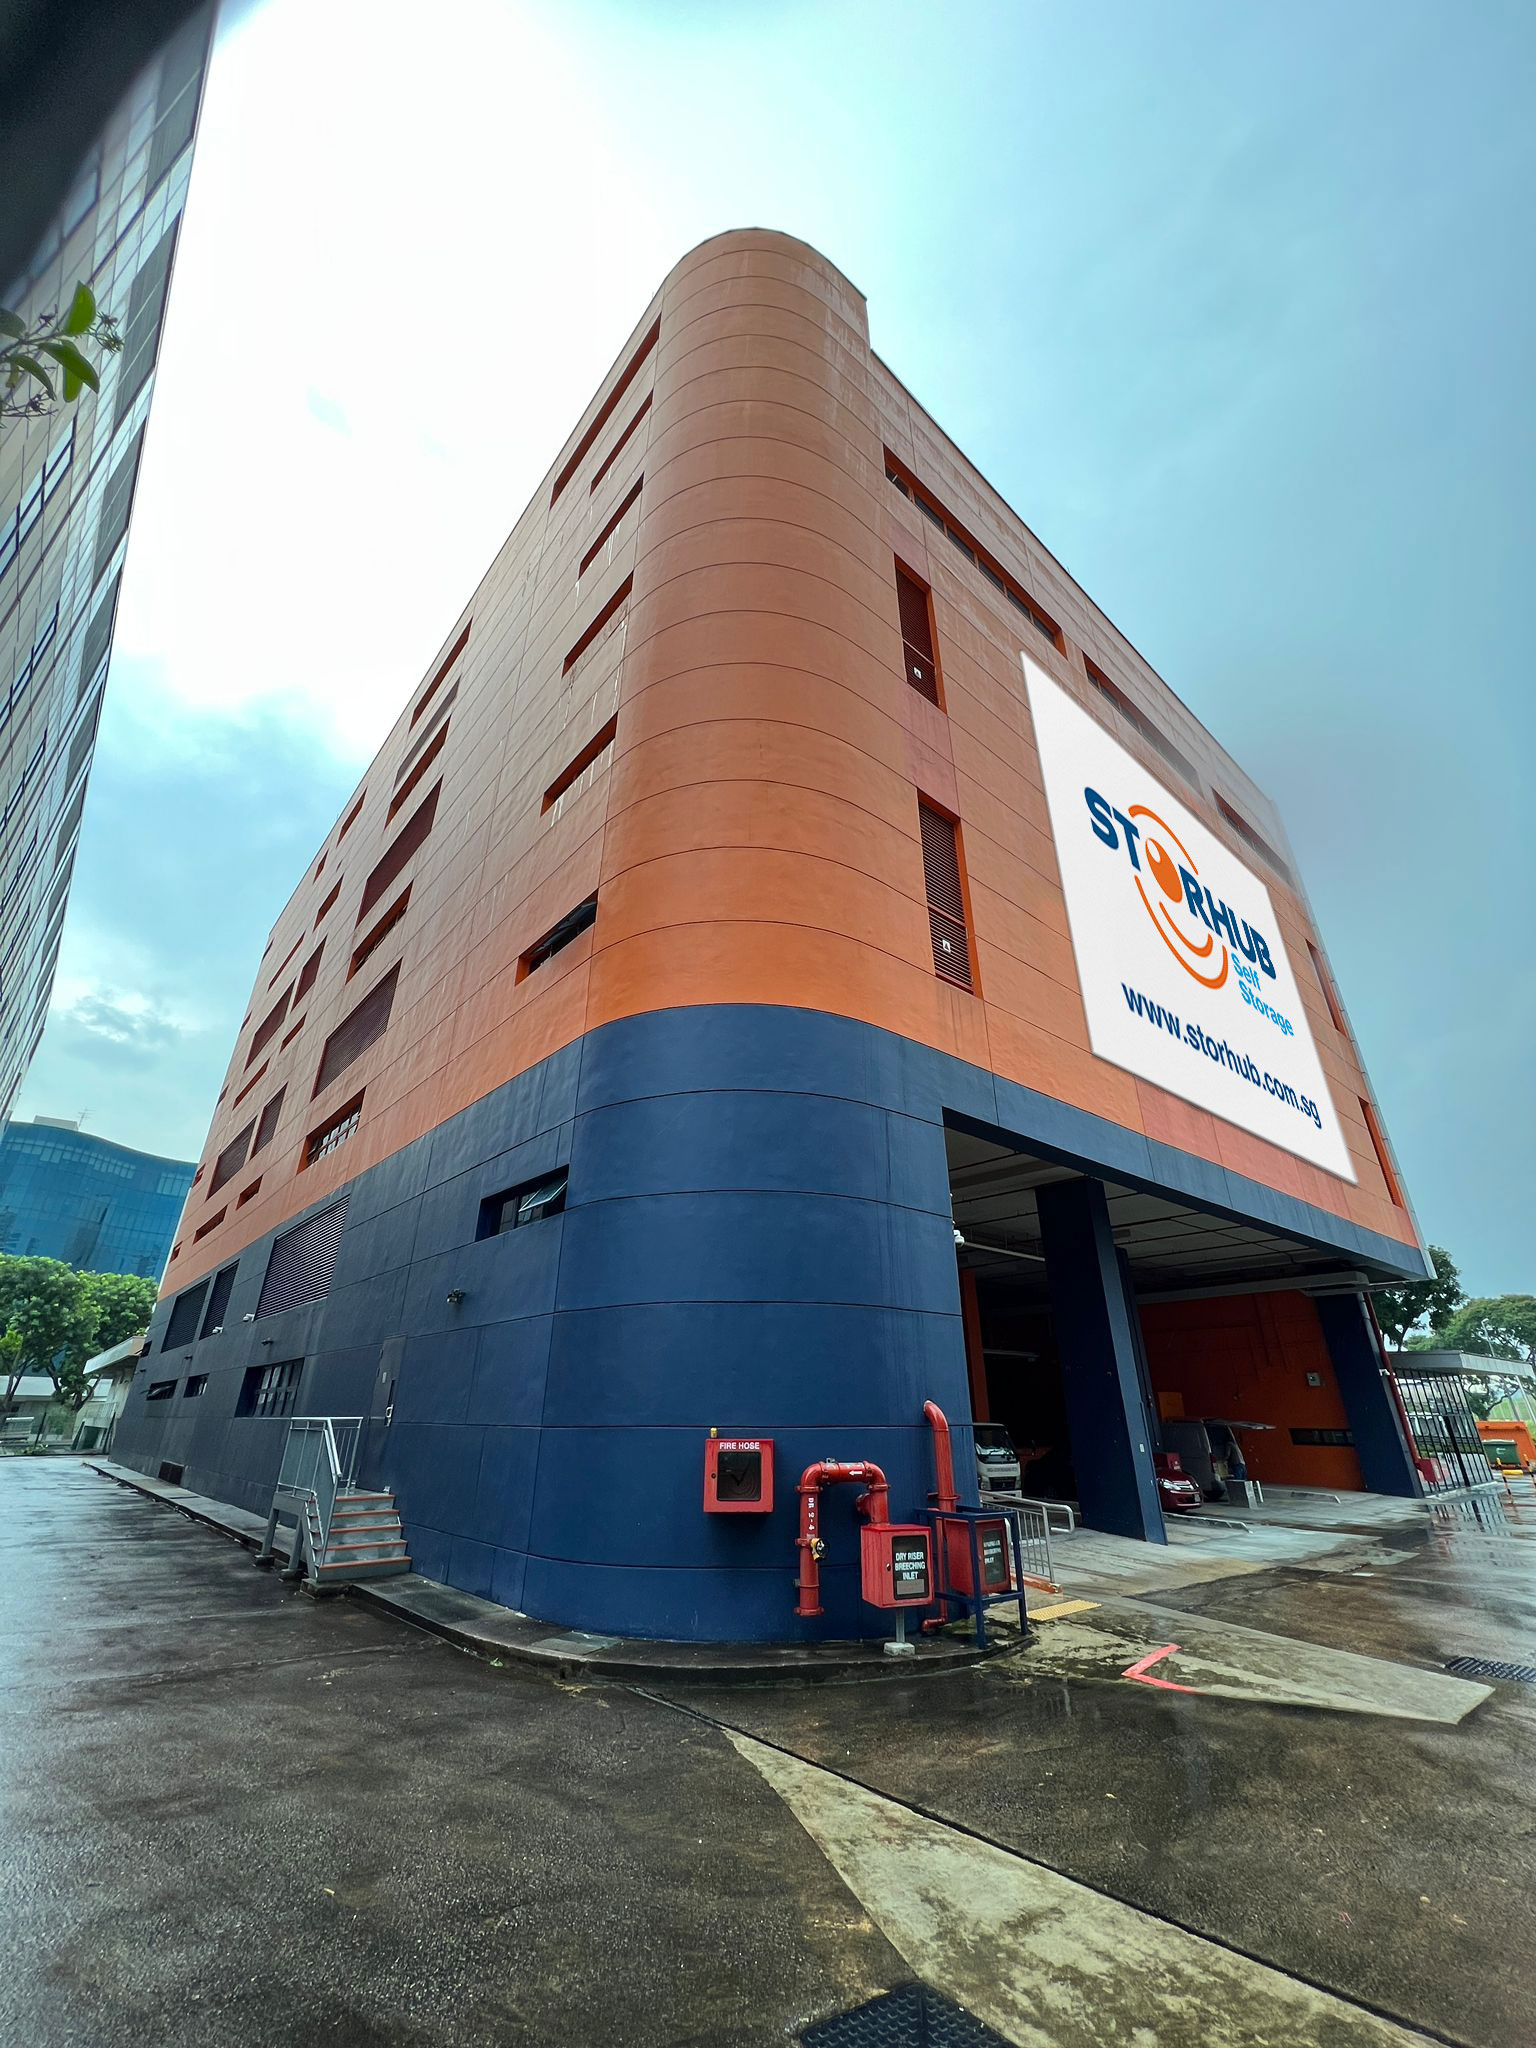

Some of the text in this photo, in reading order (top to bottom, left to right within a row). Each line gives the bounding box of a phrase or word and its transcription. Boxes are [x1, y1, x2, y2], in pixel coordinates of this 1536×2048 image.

[1084, 786, 1277, 980] STORHUB
[1231, 952, 1262, 992] Self
[1238, 979, 1295, 1037] Storage
[1121, 982, 1323, 1130] www.storhub.com.sg
[719, 1441, 760, 1450] FIRE HOSE
[894, 1561, 926, 1571] BREECHING
[895, 1551, 924, 1561] DRY RISER
[902, 1571, 919, 1580] INLET
